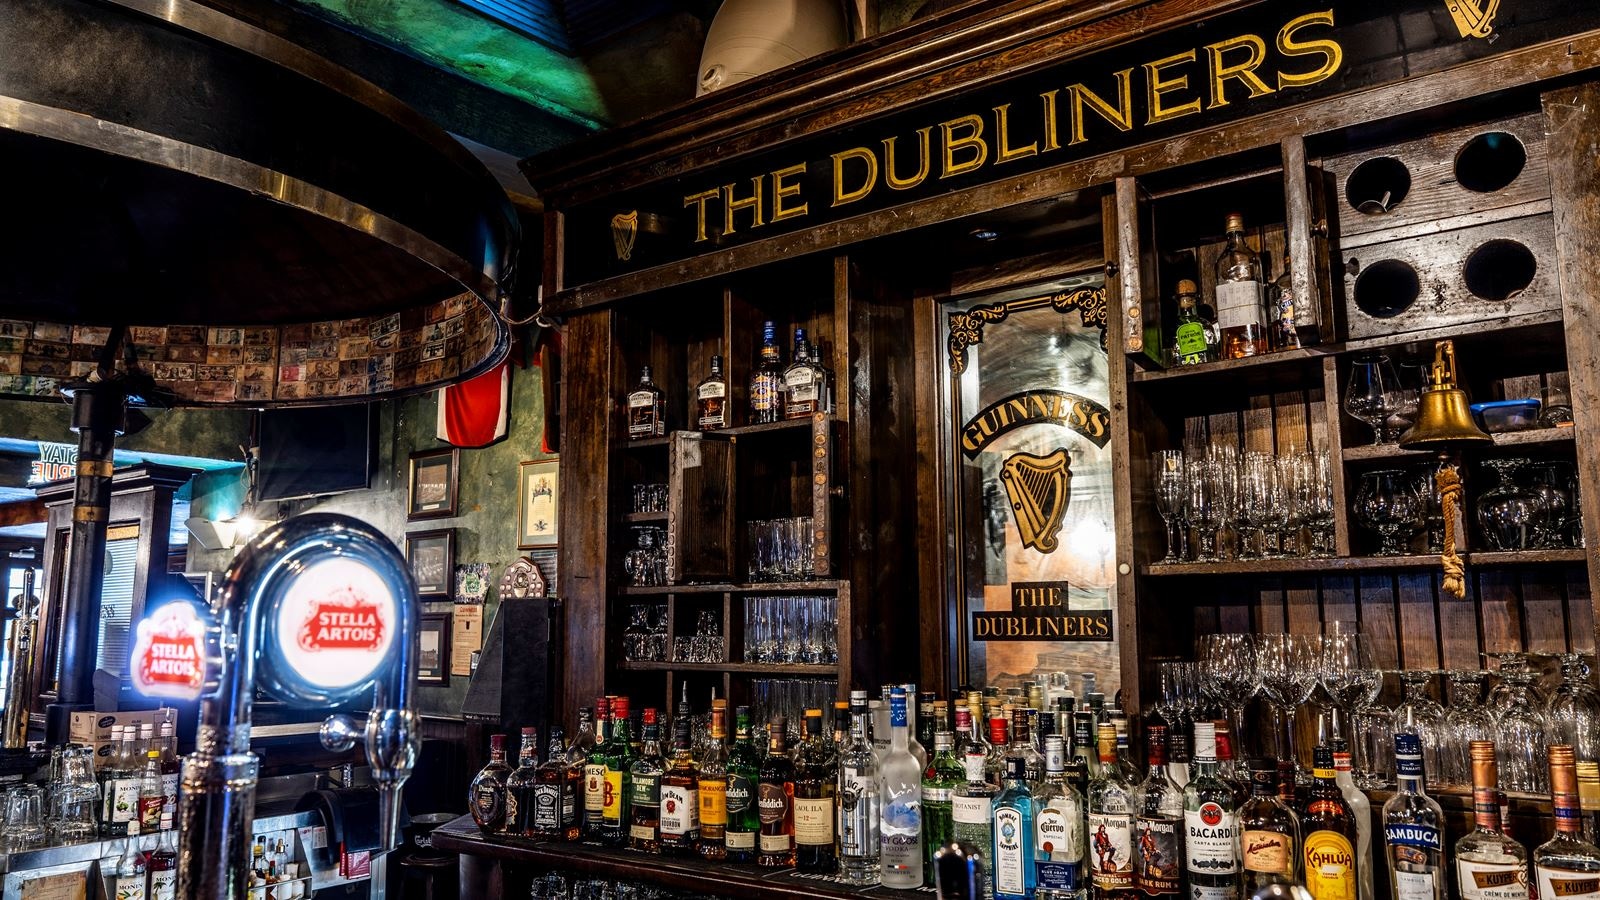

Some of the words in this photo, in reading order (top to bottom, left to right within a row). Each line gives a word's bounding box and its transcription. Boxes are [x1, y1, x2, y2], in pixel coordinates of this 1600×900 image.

[684, 161, 809, 243] THE
[830, 9, 1343, 208] DUBLINERS
[962, 393, 1109, 451] GUINNESS
[1015, 587, 1062, 607] THE
[319, 612, 376, 626] STELLA
[975, 616, 1108, 637] DUBLINERS
[316, 627, 376, 641] ARTOIS
[151, 643, 195, 659] STELLA
[150, 659, 195, 676] ARTOIS
[668, 790, 684, 804] BEAM
[1040, 822, 1064, 833] Cuervo
[1104, 818, 1126, 829] Morgan
[1149, 821, 1174, 834] Morgan
[892, 835, 919, 846] GOOSE
[1386, 828, 1439, 845] SAMBUCA
[885, 844, 909, 852] VODKA
[1305, 847, 1352, 869] KAHLÚA
[1155, 880, 1172, 888] RUM
[1486, 874, 1517, 885] KUYPER
